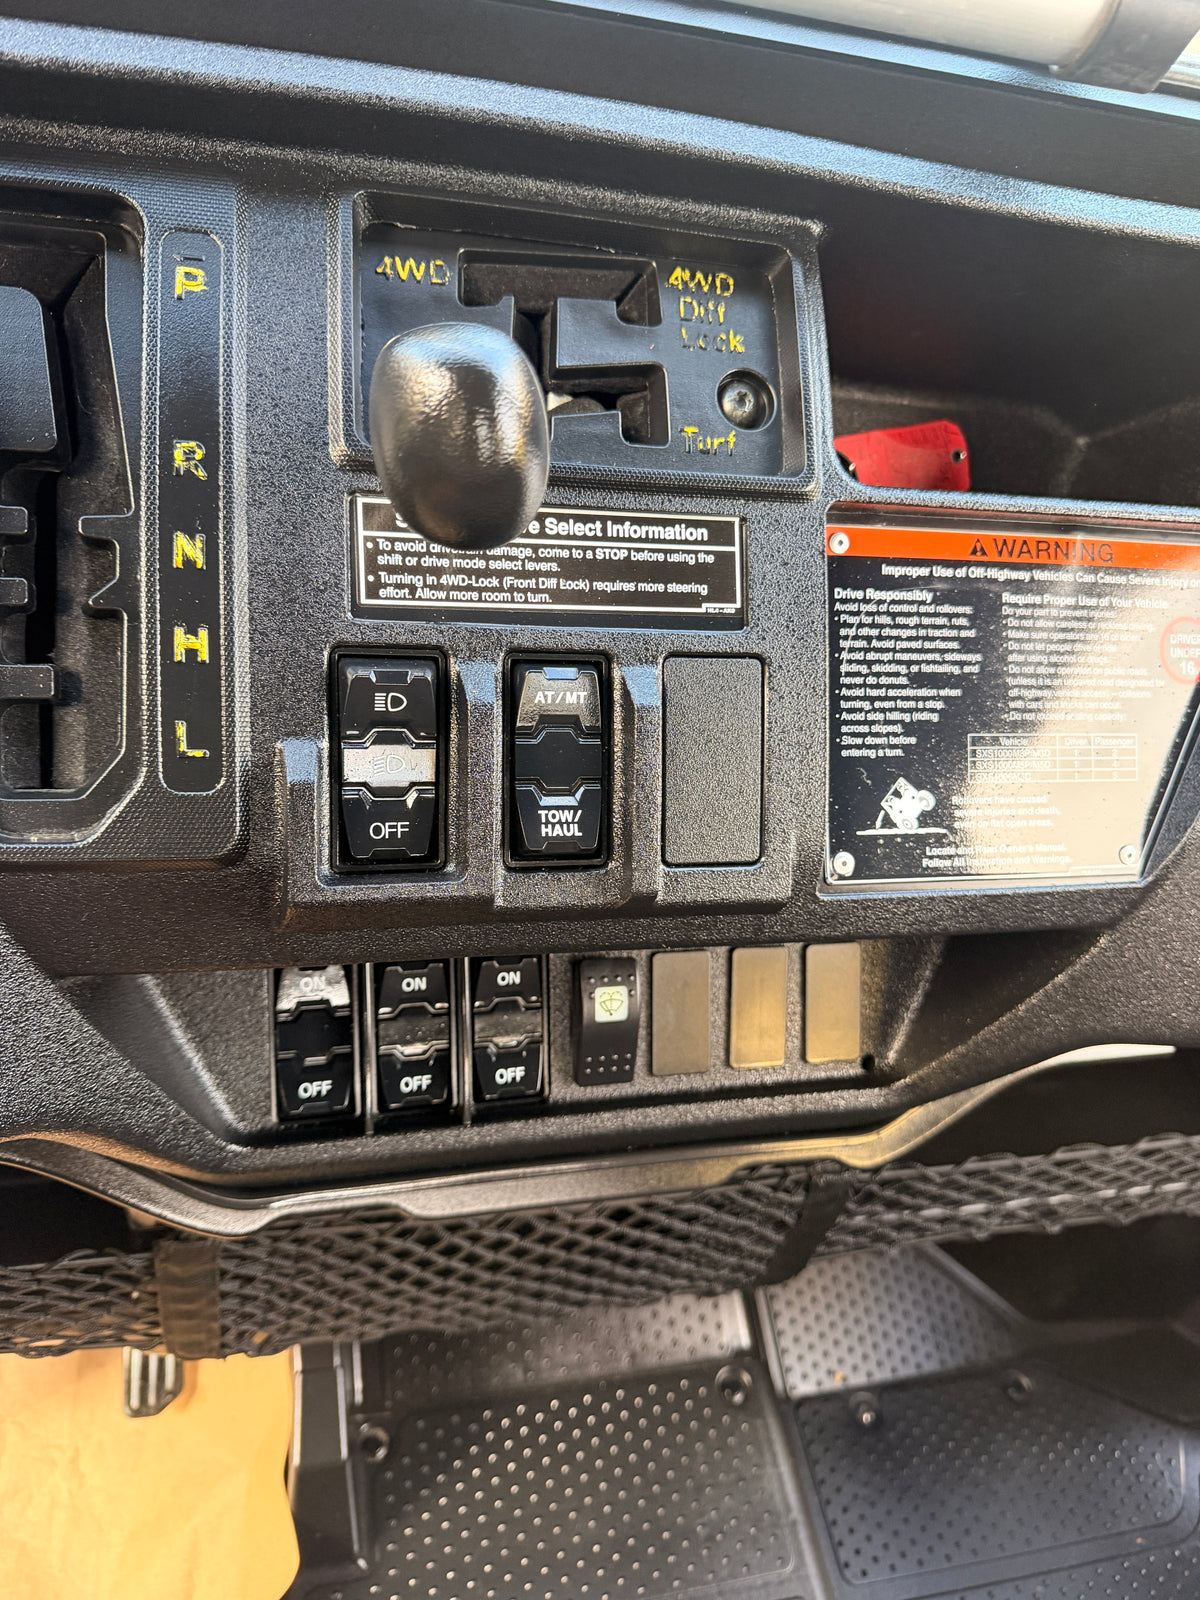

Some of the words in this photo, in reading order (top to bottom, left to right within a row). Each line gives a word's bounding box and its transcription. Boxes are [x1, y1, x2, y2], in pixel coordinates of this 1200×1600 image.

[376, 255, 452, 286] 4WD
[174, 265, 208, 299] P
[665, 266, 735, 297] 4WD
[681, 327, 746, 354] Lock
[680, 426, 736, 456] Turf
[173, 439, 208, 481] R
[544, 517, 602, 537] Select
[607, 520, 708, 541] Information
[173, 531, 206, 570] N
[377, 538, 391, 550] To
[394, 540, 426, 552] avoid
[538, 549, 570, 559] come
[572, 549, 584, 559] to
[586, 551, 593, 560] a
[596, 549, 628, 560] STOP
[630, 550, 664, 562] before
[667, 552, 696, 564] using
[698, 552, 715, 563] the
[993, 537, 1114, 563] WARNING
[377, 554, 402, 566] shift
[405, 556, 417, 566] or
[421, 556, 450, 567] drive
[453, 557, 486, 569] mode
[488, 558, 522, 570] select
[525, 560, 560, 572] levers.
[882, 564, 930, 578] Improper
[932, 565, 953, 577] Use
[955, 566, 968, 578] of
[968, 566, 1031, 582] Off-Highway
[1033, 569, 1074, 582] Vehicles
[1076, 572, 1096, 584] Can
[1098, 573, 1127, 584] Cause
[378, 572, 423, 588] Turning
[426, 574, 437, 585] in
[440, 574, 500, 588] 4WD-Lock
[503, 576, 536, 590] (Front
[539, 578, 558, 589] Diff
[560, 578, 590, 592] Lock)
[592, 581, 636, 594] requires
[638, 582, 664, 592] more
[667, 583, 708, 596] steering
[379, 588, 412, 599] effort.
[415, 588, 446, 600] Allow
[450, 590, 479, 600] more
[482, 592, 512, 602] room
[513, 591, 525, 602] to
[527, 592, 552, 603] turn.
[834, 588, 864, 600] Drive
[866, 589, 934, 602] Responsibly
[1002, 592, 1042, 606] Require
[1044, 594, 1077, 607] Proper
[1078, 595, 1098, 607] Use
[1098, 596, 1108, 607] of
[1110, 596, 1132, 608] Your
[834, 602, 858, 612] Avoid
[860, 603, 877, 612] loss
[878, 603, 888, 612] of
[889, 604, 918, 613] control
[919, 604, 935, 613] and
[840, 614, 860, 624] Plan
[861, 615, 873, 624] for
[896, 616, 920, 627] rough
[840, 628, 856, 636] and
[858, 628, 880, 637] other
[881, 628, 917, 638] changes
[918, 628, 926, 637] in
[928, 628, 958, 638] traction
[960, 628, 976, 638] and
[173, 626, 209, 664] H
[870, 639, 895, 648] Avoid
[896, 640, 922, 650] paved
[840, 651, 864, 661] Avoid
[866, 652, 894, 662] abrupt
[910, 665, 920, 673] or
[962, 664, 980, 673] and
[840, 676, 864, 685] never
[866, 676, 878, 684] do
[534, 690, 588, 704] AT/MT
[840, 687, 866, 696] Avoid
[866, 688, 886, 696] hard
[887, 688, 938, 697] acceleration
[939, 688, 963, 697] when
[874, 701, 896, 709] even
[896, 700, 916, 709] from
[840, 712, 865, 721] Avoid
[866, 712, 885, 721] side
[886, 712, 911, 722] hilling
[912, 712, 940, 722] (riding
[840, 724, 870, 733] across
[174, 720, 209, 758] L
[840, 736, 864, 746] Slow
[864, 736, 888, 744] down
[889, 736, 917, 744] before
[840, 748, 876, 758] entering
[538, 810, 582, 824] TOW/
[369, 822, 410, 840] OFF
[541, 824, 583, 837] HAUL
[300, 976, 327, 992] ON
[402, 976, 427, 993] ON
[496, 970, 521, 987] ON
[400, 1074, 433, 1094] OFF
[494, 1066, 526, 1085] OFF
[298, 1080, 333, 1100] OFF
